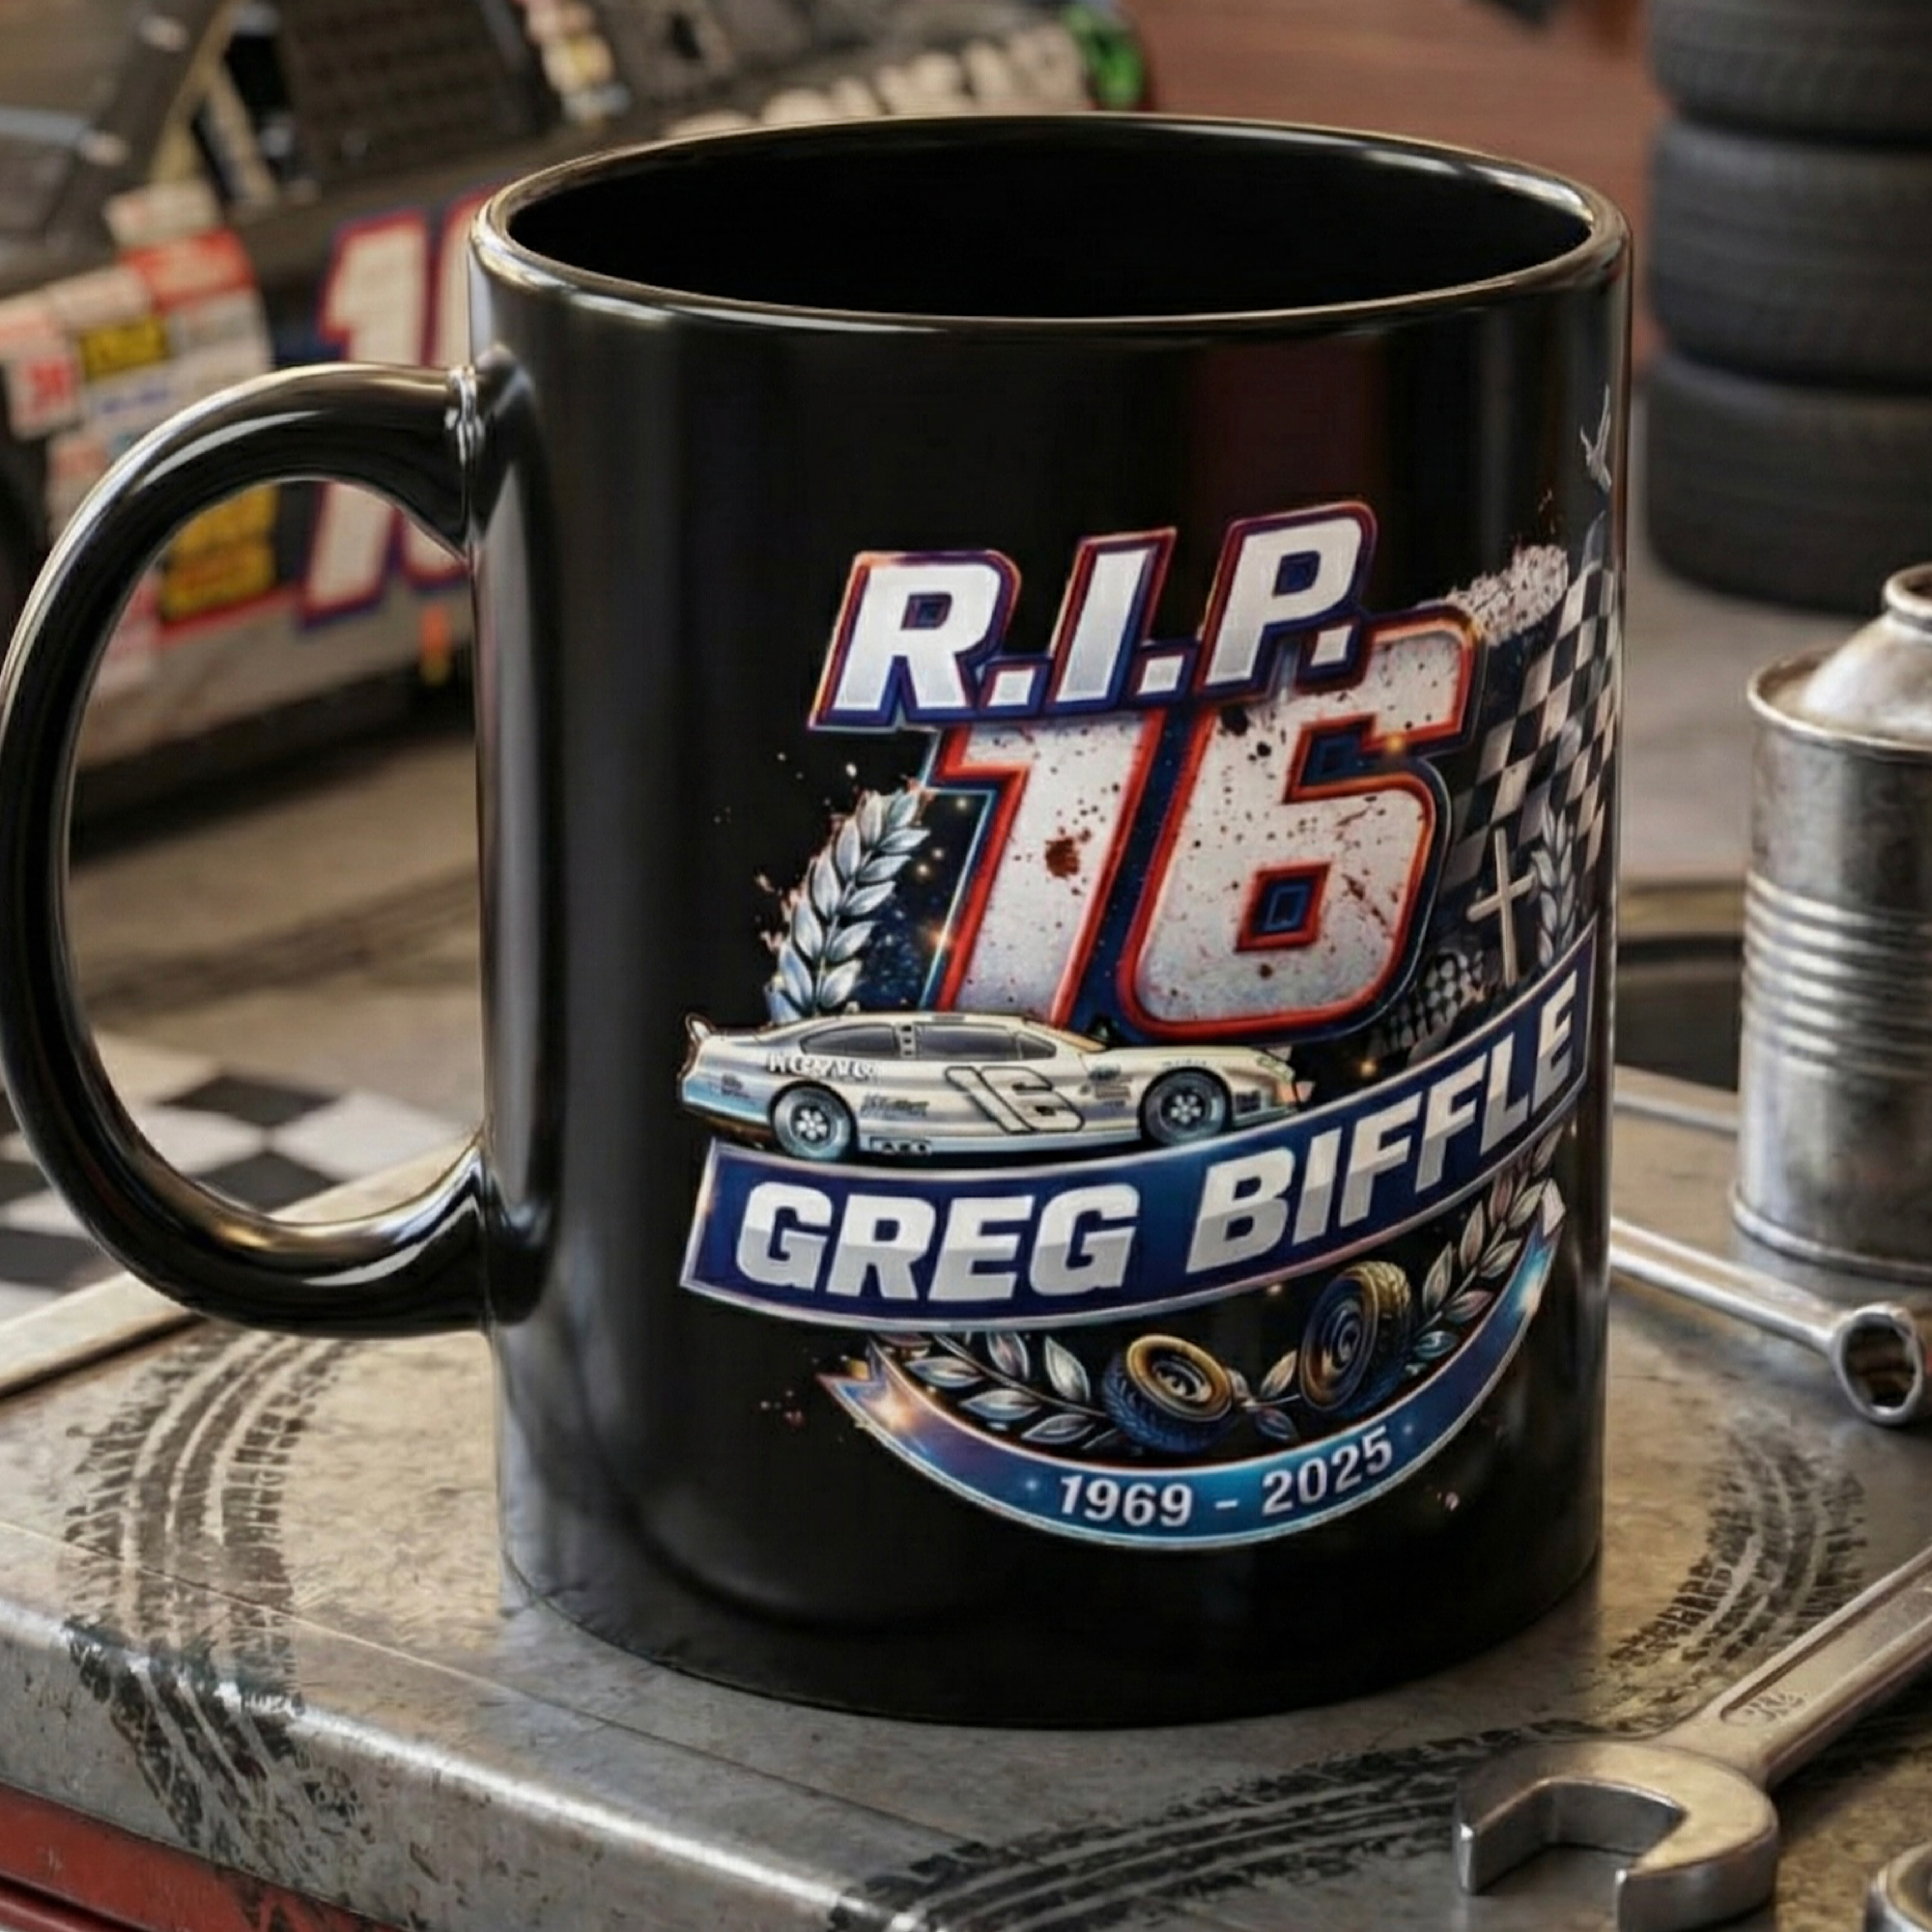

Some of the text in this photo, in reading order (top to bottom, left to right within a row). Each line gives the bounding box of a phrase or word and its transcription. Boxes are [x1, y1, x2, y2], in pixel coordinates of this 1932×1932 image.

[821, 508, 1367, 721] R.I.P.
[932, 607, 1480, 1043] 16
[735, 970, 1577, 1303] GREG BIFFLE
[945, 1065, 1085, 1135] 16
[1059, 1473, 1193, 1528] 1969
[1262, 1425, 1394, 1517] 2025
